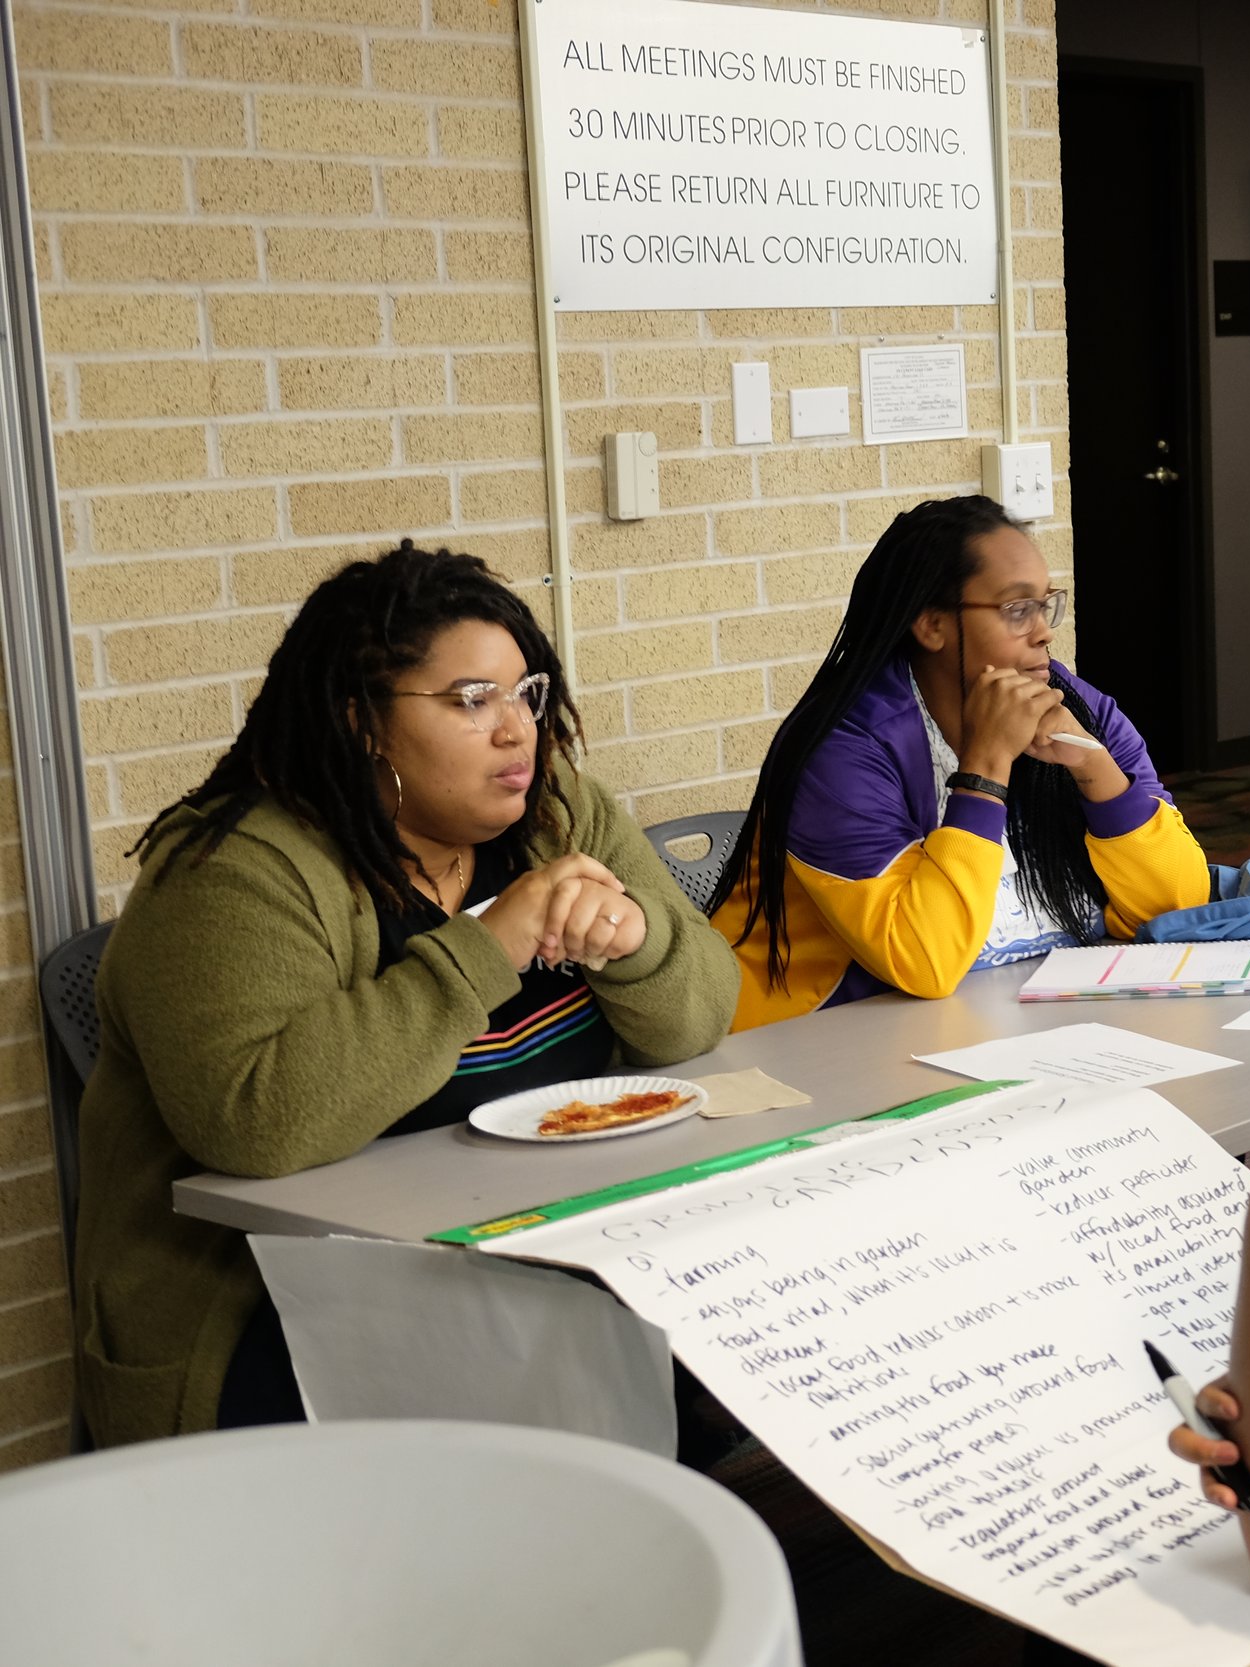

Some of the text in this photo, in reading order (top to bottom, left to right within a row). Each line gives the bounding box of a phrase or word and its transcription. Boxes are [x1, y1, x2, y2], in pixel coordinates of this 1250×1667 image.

[563, 40, 966, 96] ALL MEETINGS MUST BE FINISHED
[569, 108, 967, 156] 30 MINUTES PRIOR TO CLOSING.
[565, 171, 980, 210] PLEASE RETURN ALL FURNITURE TO
[581, 234, 967, 264] ITS ORIGINAL CONFIGURATION.
[1013, 1126, 1161, 1177] value community
[1019, 1164, 1096, 1201] garden
[998, 1238, 1017, 1253] is
[1117, 1226, 1167, 1253] local
[1170, 1209, 1217, 1235] food
[1133, 1226, 1244, 1277] availability
[664, 1245, 769, 1293] farming
[699, 1232, 928, 1319] enjoys being in garden
[828, 1344, 887, 1372] food
[944, 1302, 1007, 1332] carbon
[1038, 1275, 1080, 1296] more
[929, 1370, 975, 1398] food
[1010, 1366, 1078, 1403] around
[1076, 1354, 1125, 1377] food
